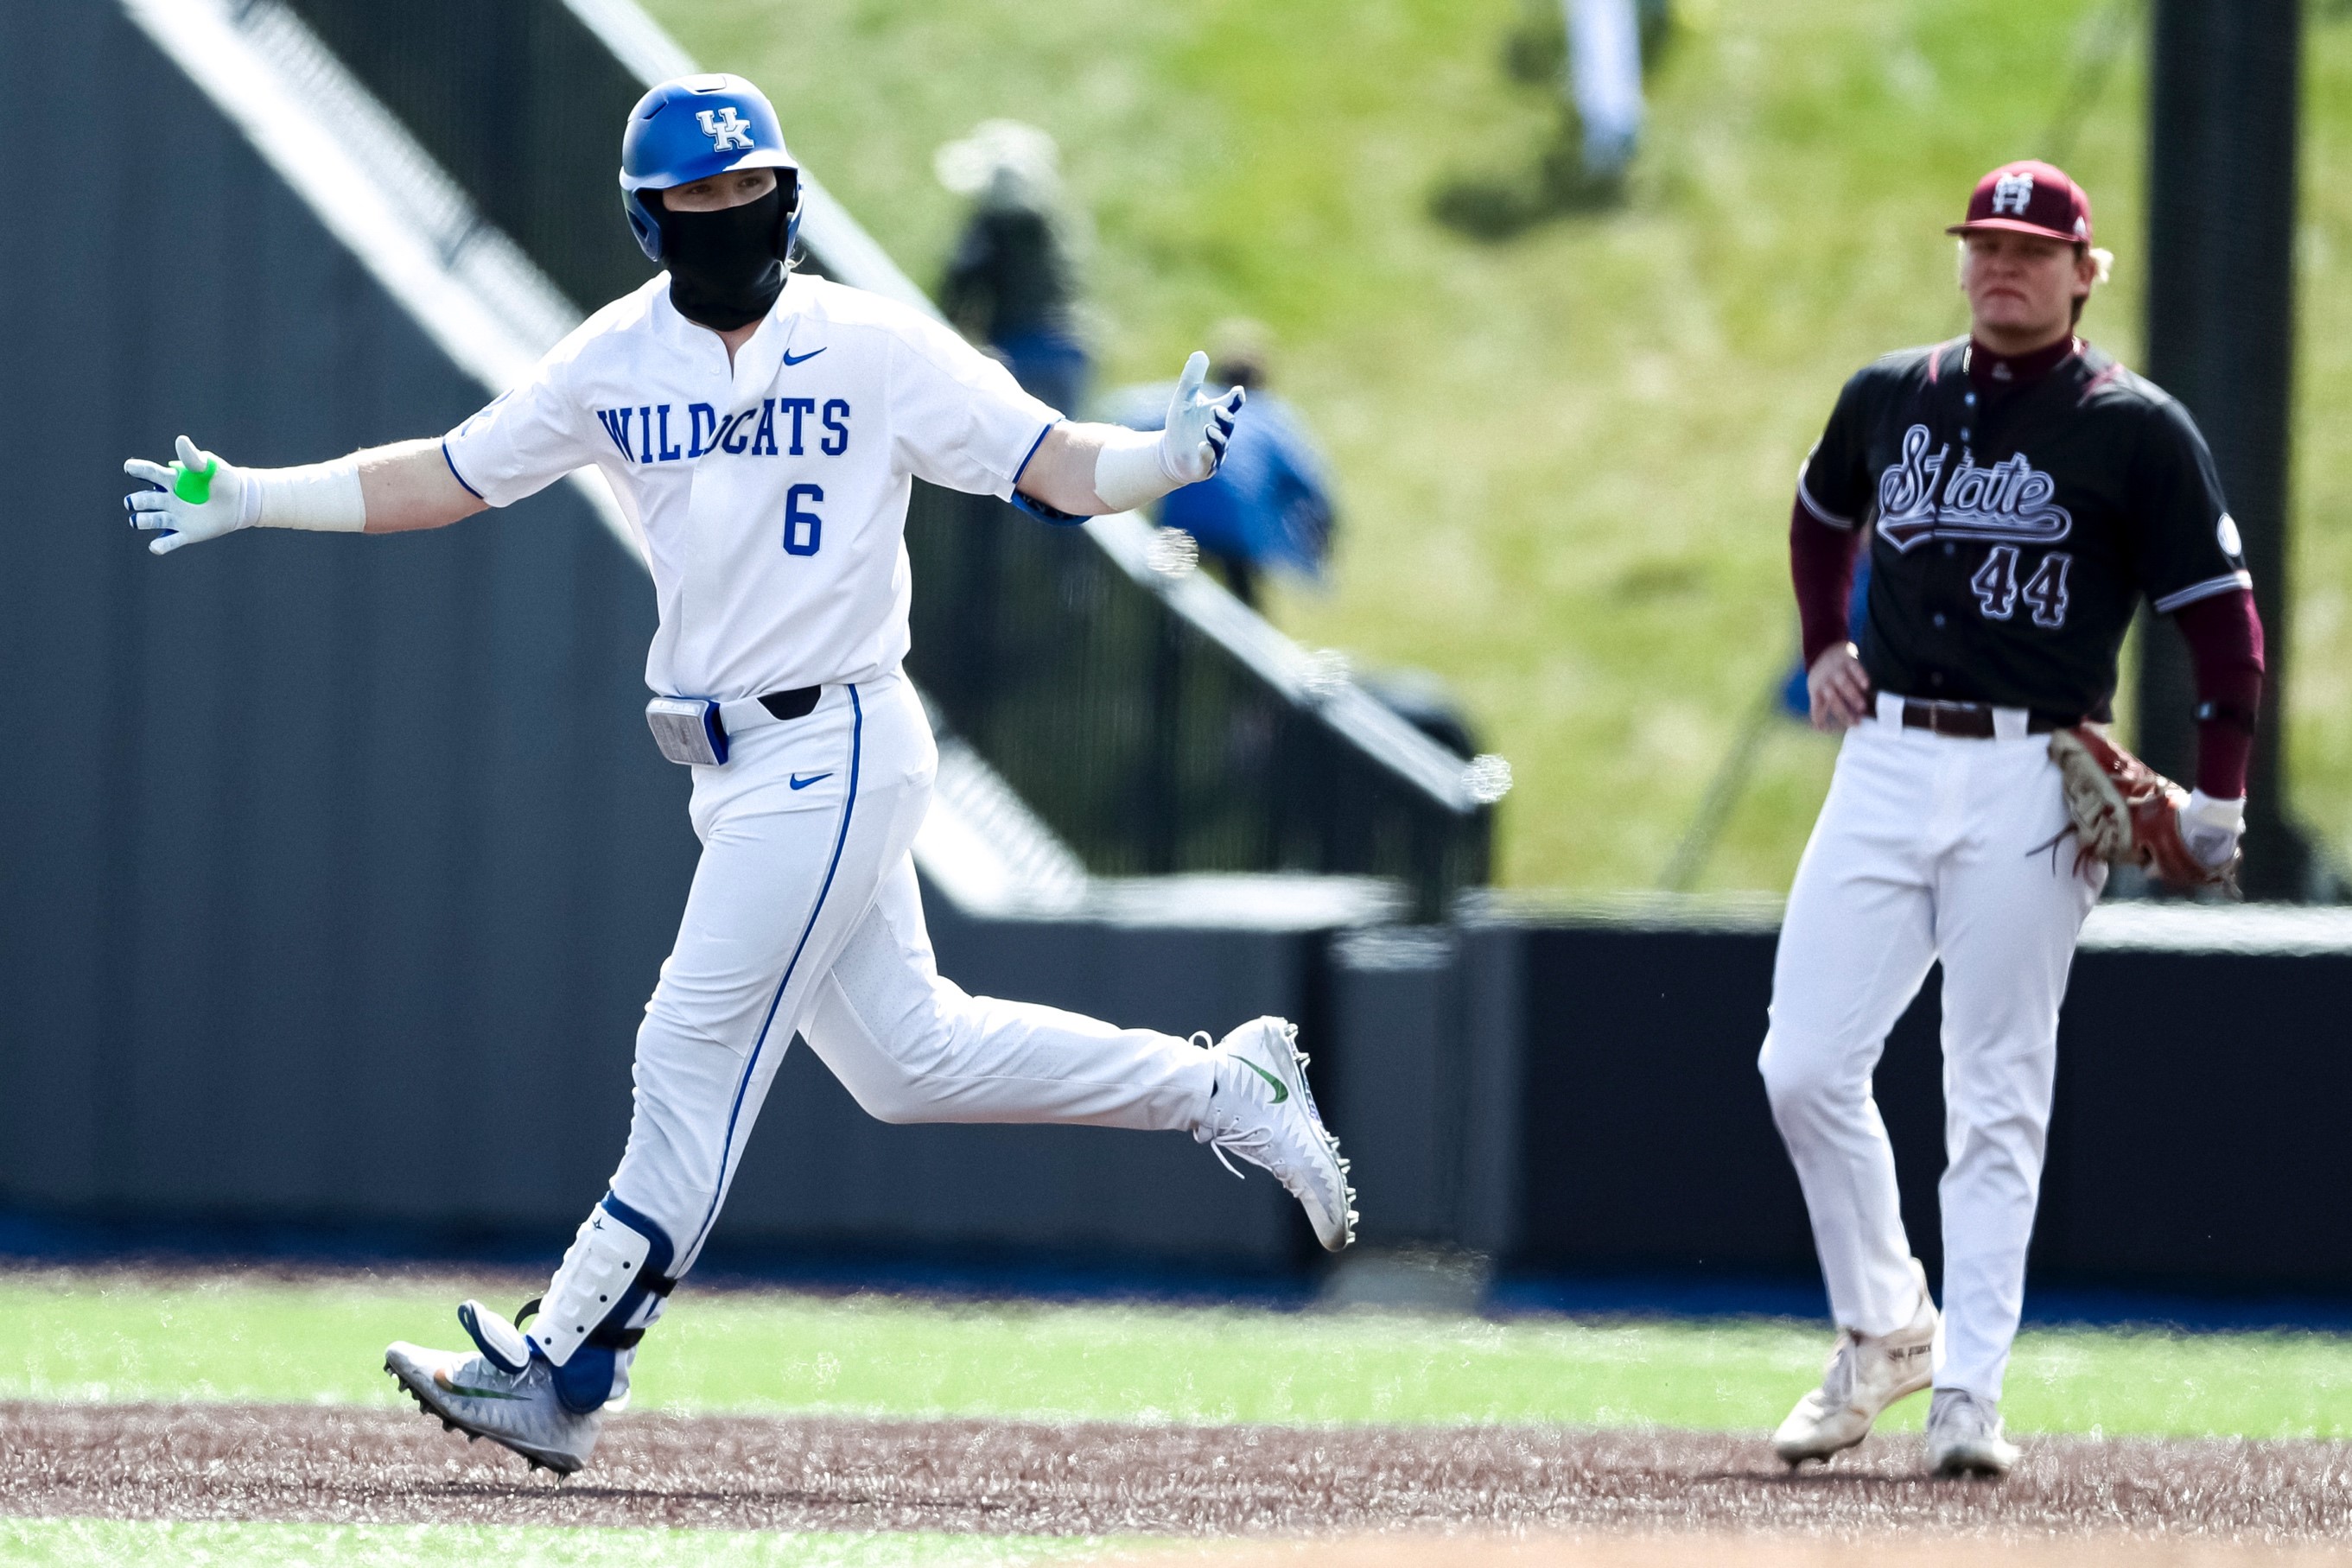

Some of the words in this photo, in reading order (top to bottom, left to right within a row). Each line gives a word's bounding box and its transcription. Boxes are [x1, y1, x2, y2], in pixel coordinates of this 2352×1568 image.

[696, 107, 754, 152] UK
[596, 398, 850, 464] WILDCATS
[783, 483, 823, 556] 6
[1876, 423, 2072, 553] State
[1971, 546, 2072, 628] 44
